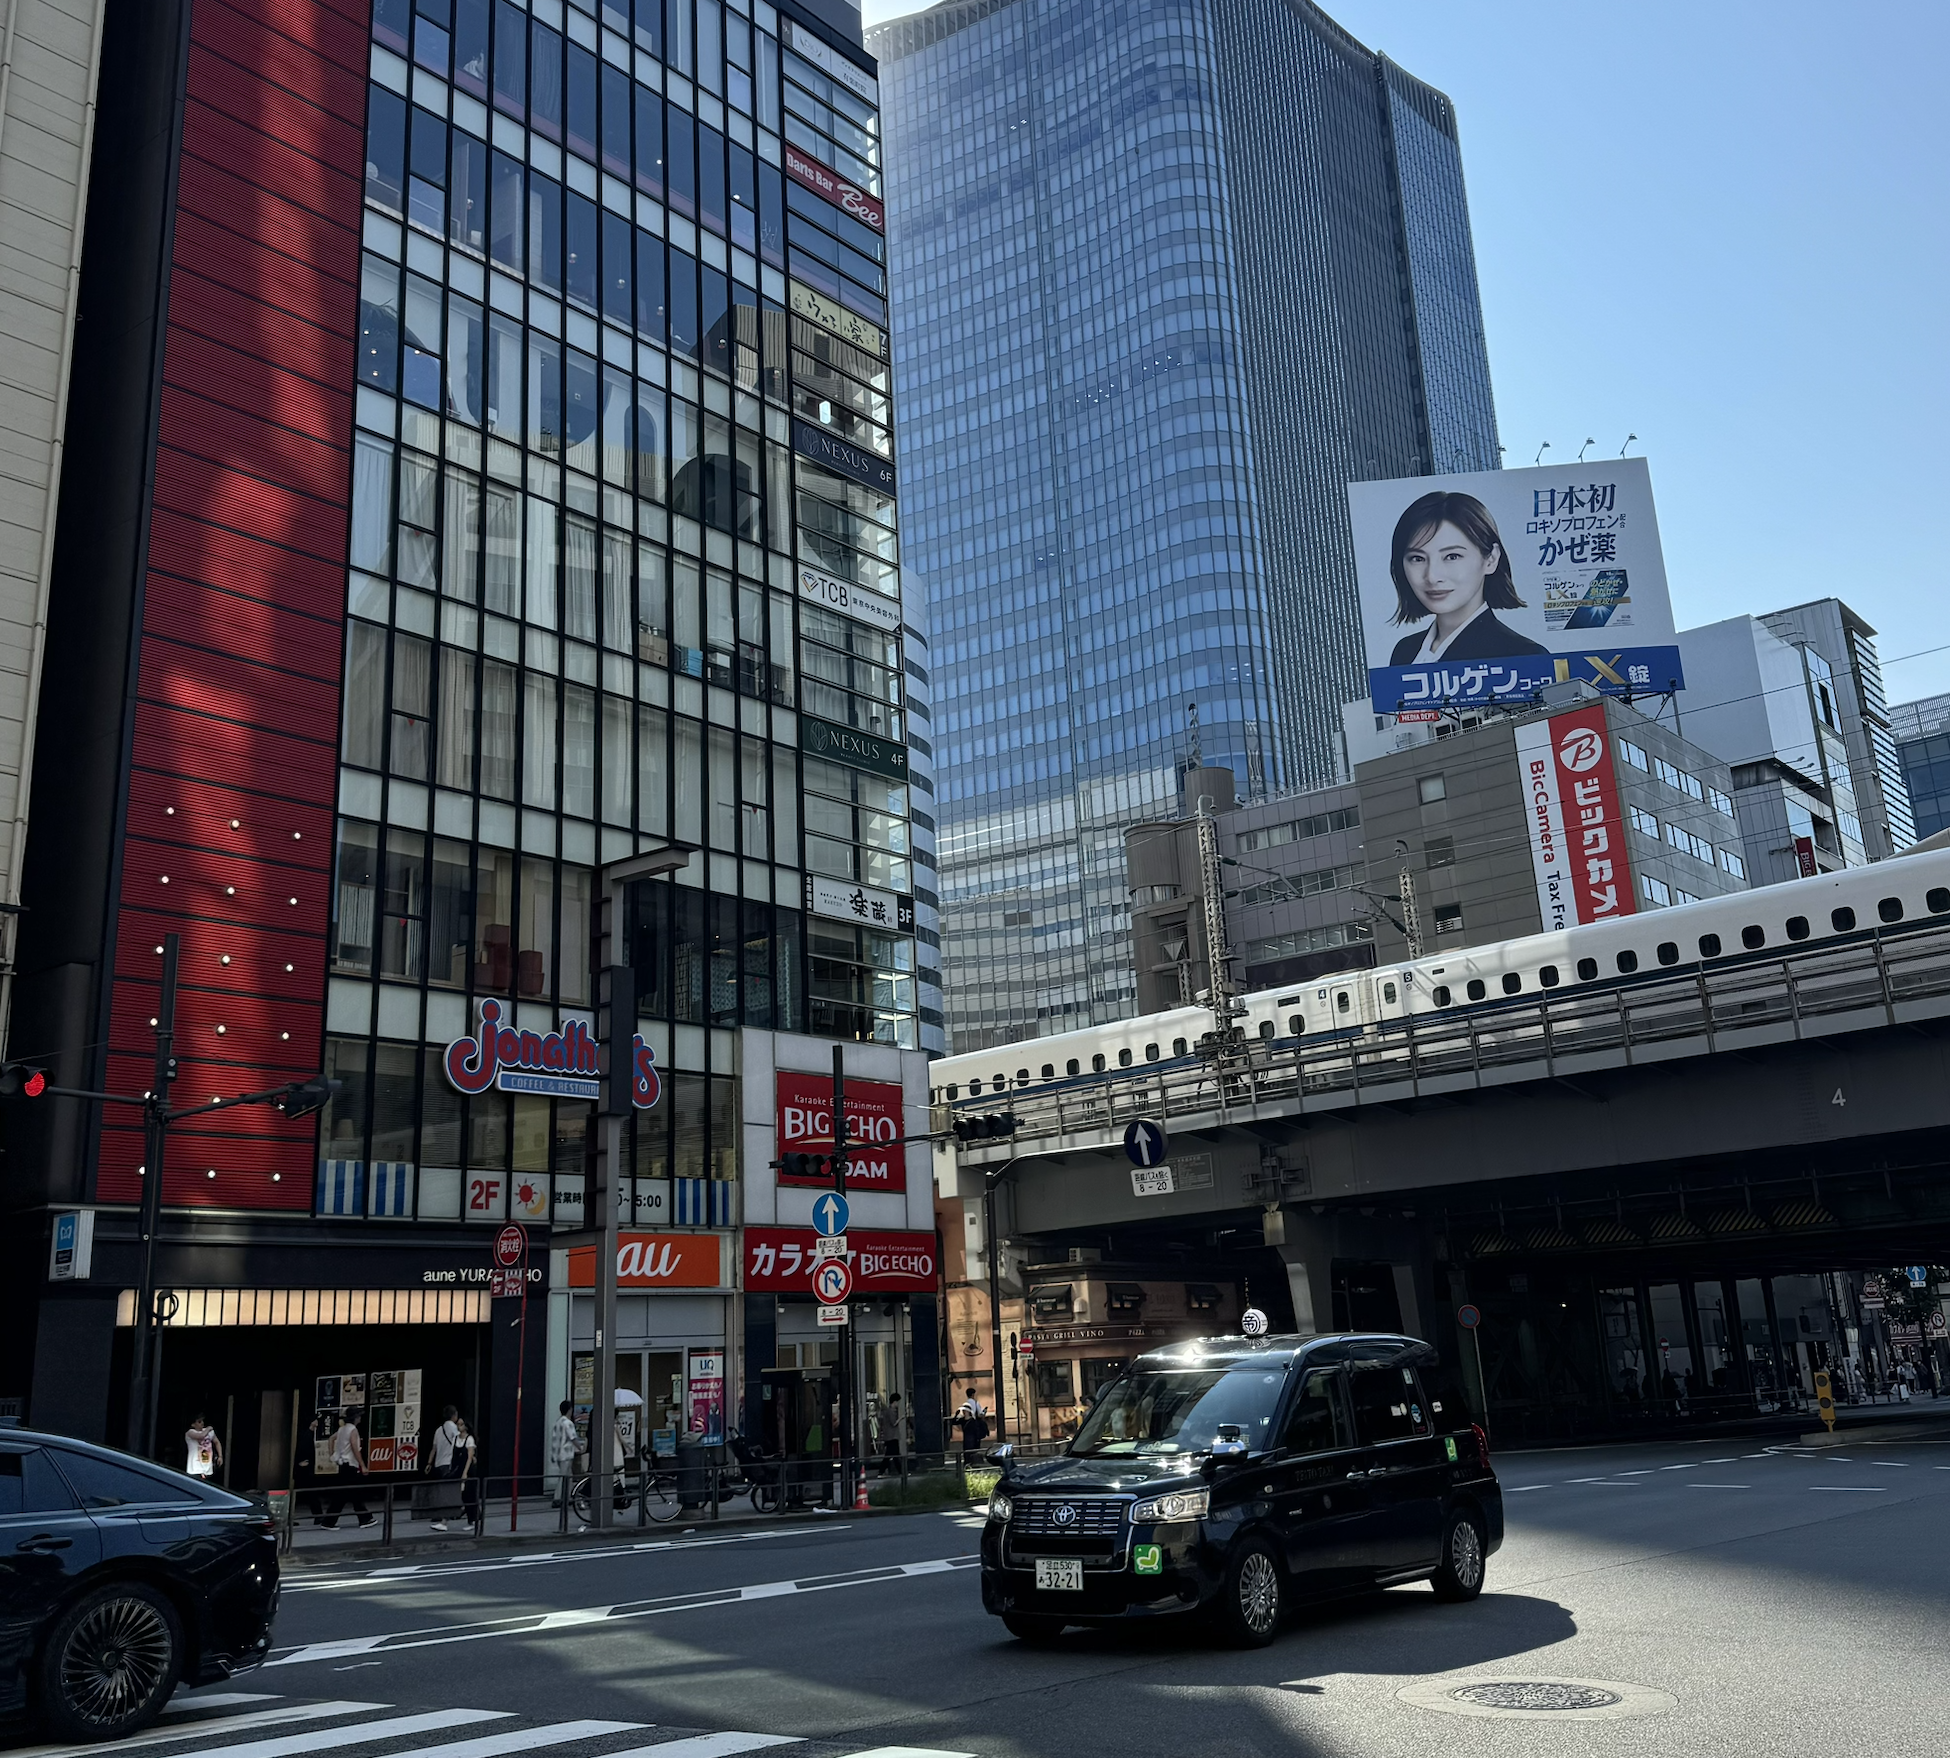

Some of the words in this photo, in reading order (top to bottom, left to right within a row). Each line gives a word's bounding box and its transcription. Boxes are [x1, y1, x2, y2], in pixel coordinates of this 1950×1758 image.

[786, 152, 815, 182] Darts
[815, 172, 833, 192] Bar
[837, 183, 882, 227] Bee
[880, 333, 887, 356] 7F
[821, 438, 869, 473] NEXUS
[880, 470, 892, 482] 6F
[1534, 483, 1617, 517] 日本初
[1526, 515, 1619, 535] ロキソプロフェン
[1619, 513, 1626, 529] 配合
[1538, 532, 1616, 566] かぜ薬
[818, 578, 848, 607] TCB
[1546, 589, 1570, 600] LX
[1628, 664, 1650, 683] 錠
[830, 730, 880, 760] NEXUS
[890, 753, 904, 766] 4F
[1530, 759, 1555, 864] BicCamera
[1547, 870, 1561, 902] Tax
[1574, 777, 1620, 922] ビックカメ
[1800, 852, 1811, 869] BIG
[849, 888, 887, 925] 楽蔵
[898, 907, 912, 923] 3F
[1319, 990, 1325, 998] 4
[511, 1077, 545, 1090] COFFEE
[794, 1094, 827, 1106] Karaoke
[830, 1098, 885, 1112] Eertainment
[1832, 1088, 1846, 1107] 4
[784, 1106, 830, 1140] BIG
[845, 1115, 897, 1142] CHO
[470, 1179, 500, 1210] 2F
[1156, 1181, 1167, 1191] 20
[553, 1192, 585, 1204] 営業時
[888, 1245, 925, 1253] Entertainment
[617, 1242, 682, 1278] au
[861, 1253, 890, 1276] BIG
[892, 1255, 933, 1276] ECHO
[423, 1271, 456, 1282] aune
[1053, 1331, 1076, 1340] GRILL
[1079, 1329, 1105, 1338] VINO
[700, 1359, 715, 1371] UQ
[402, 1421, 415, 1431] TCB
[370, 1447, 393, 1462] au
